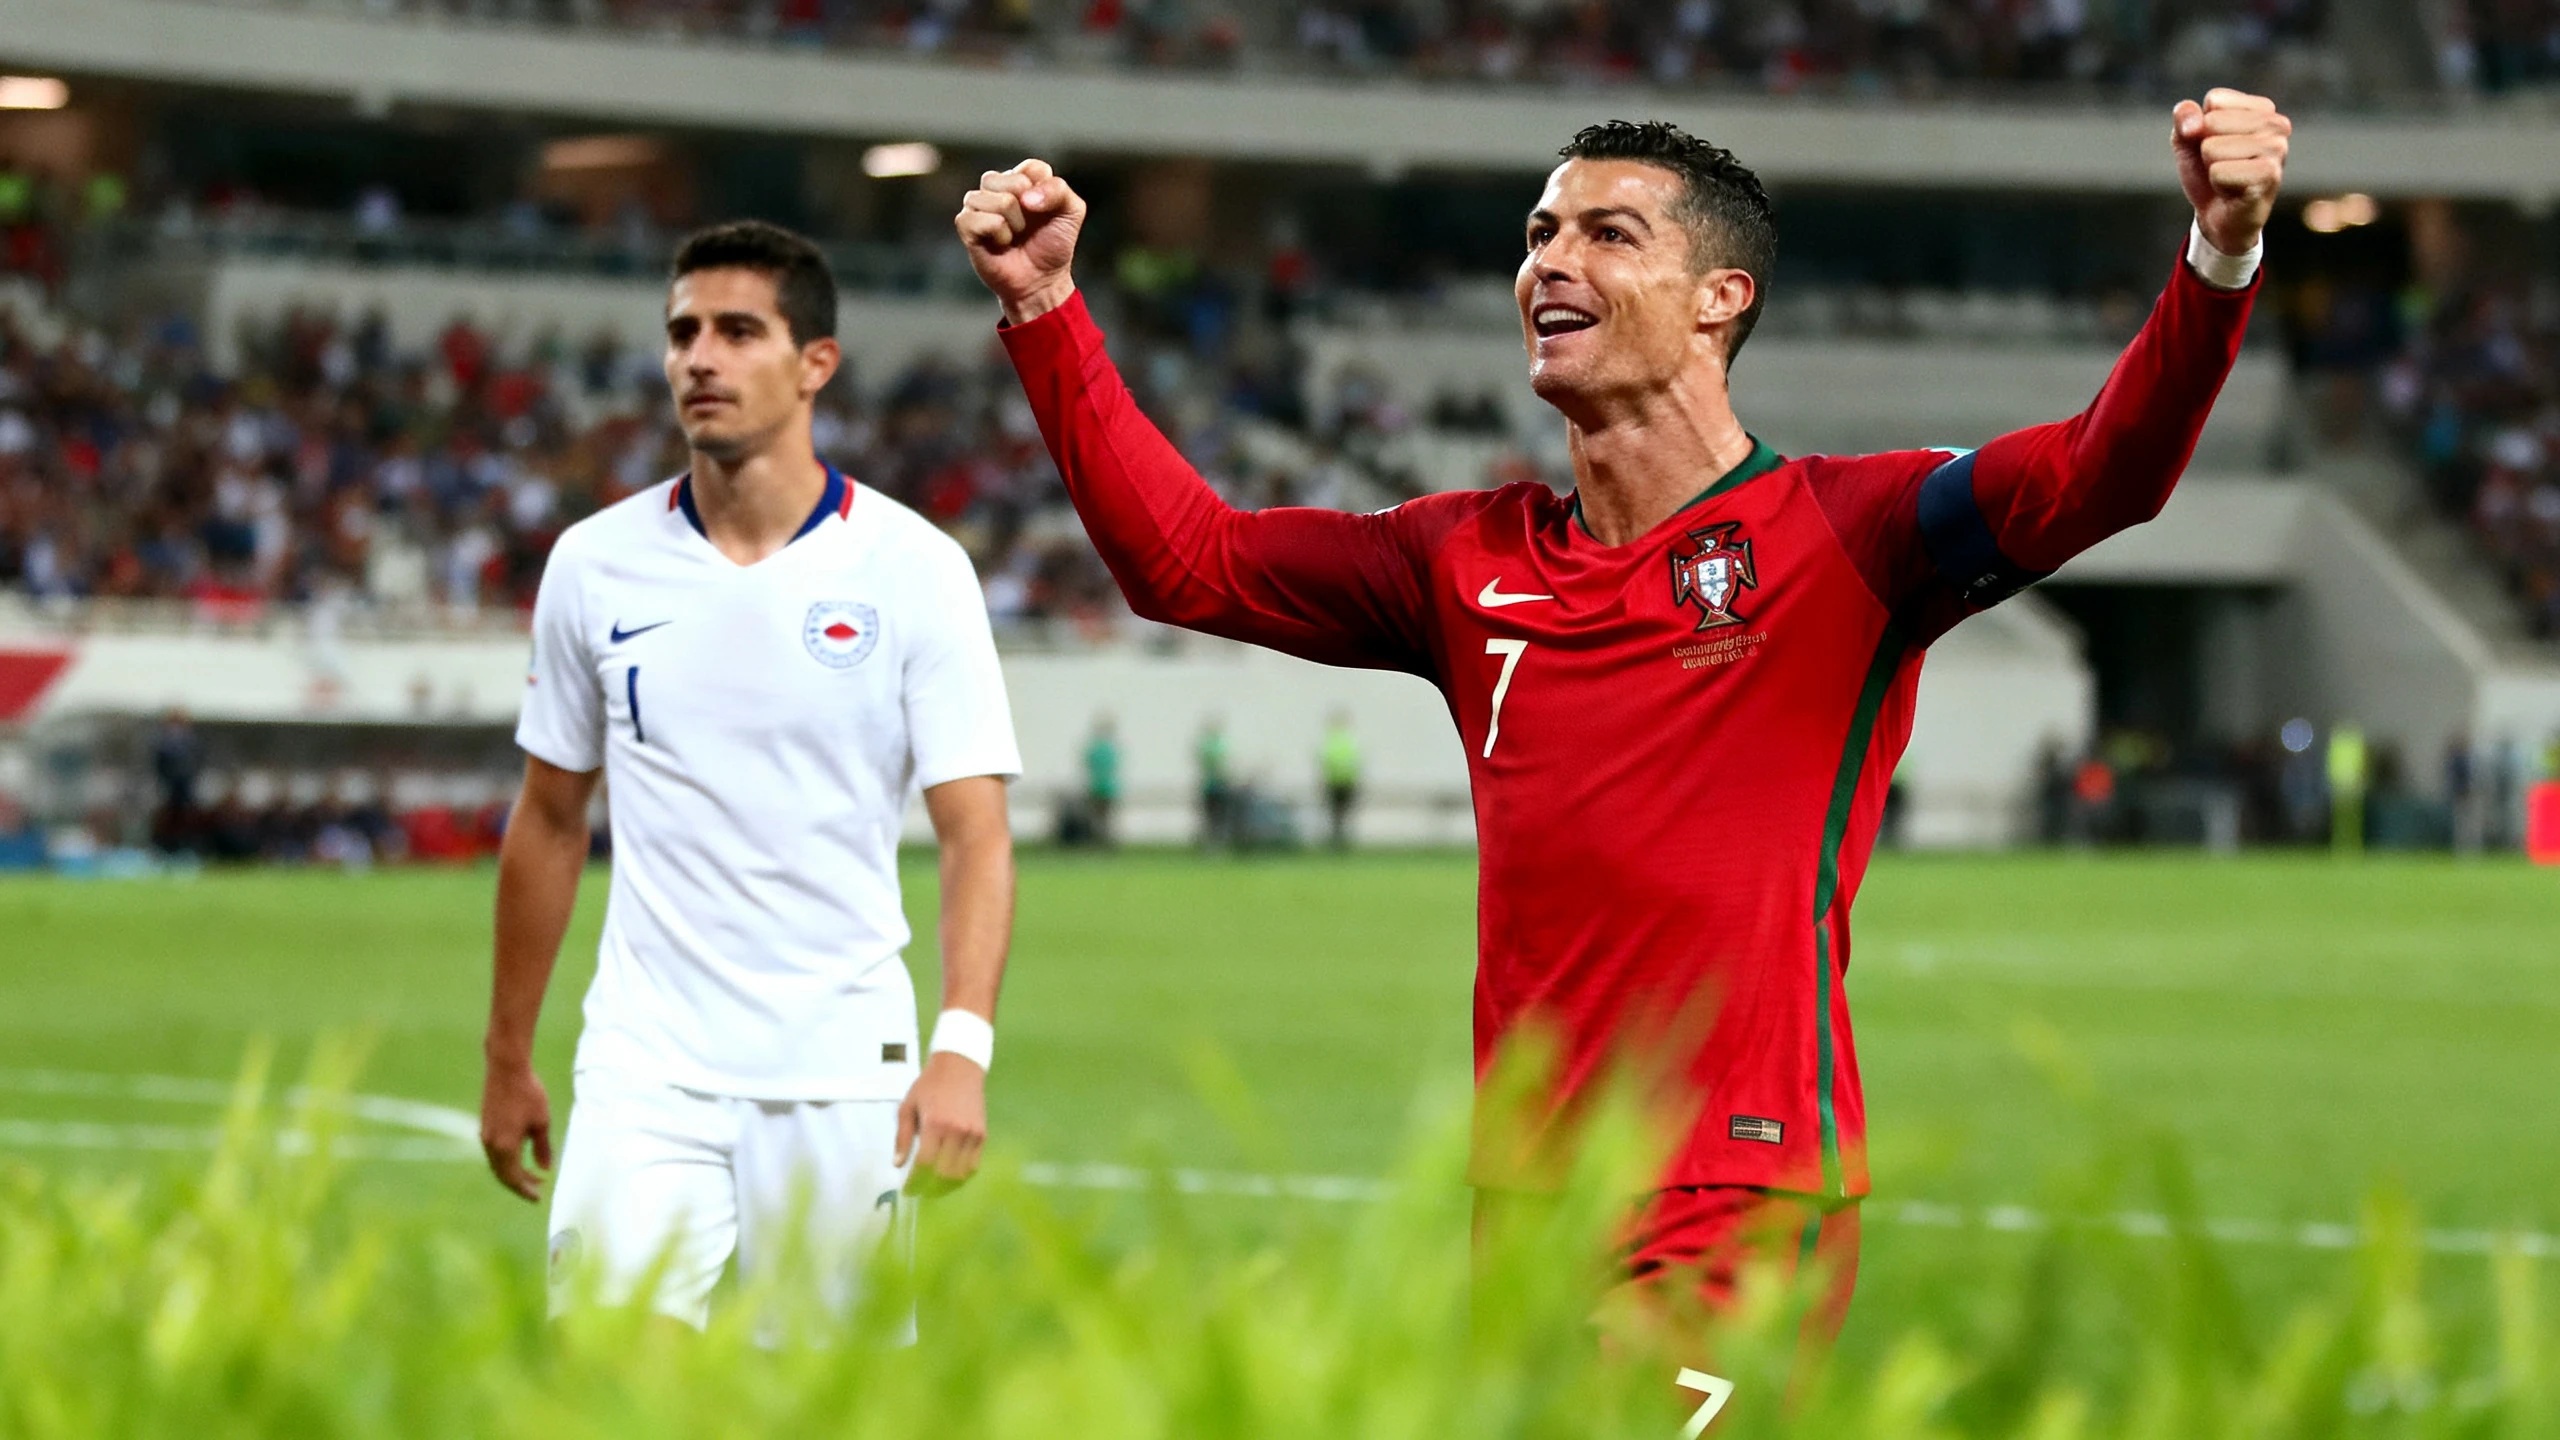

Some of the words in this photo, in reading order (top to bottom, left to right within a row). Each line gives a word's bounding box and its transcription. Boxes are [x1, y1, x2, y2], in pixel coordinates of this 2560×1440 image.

[627, 665, 645, 743] 1
[1483, 638, 1529, 758] 7
[1675, 1366, 1735, 1440] 7
